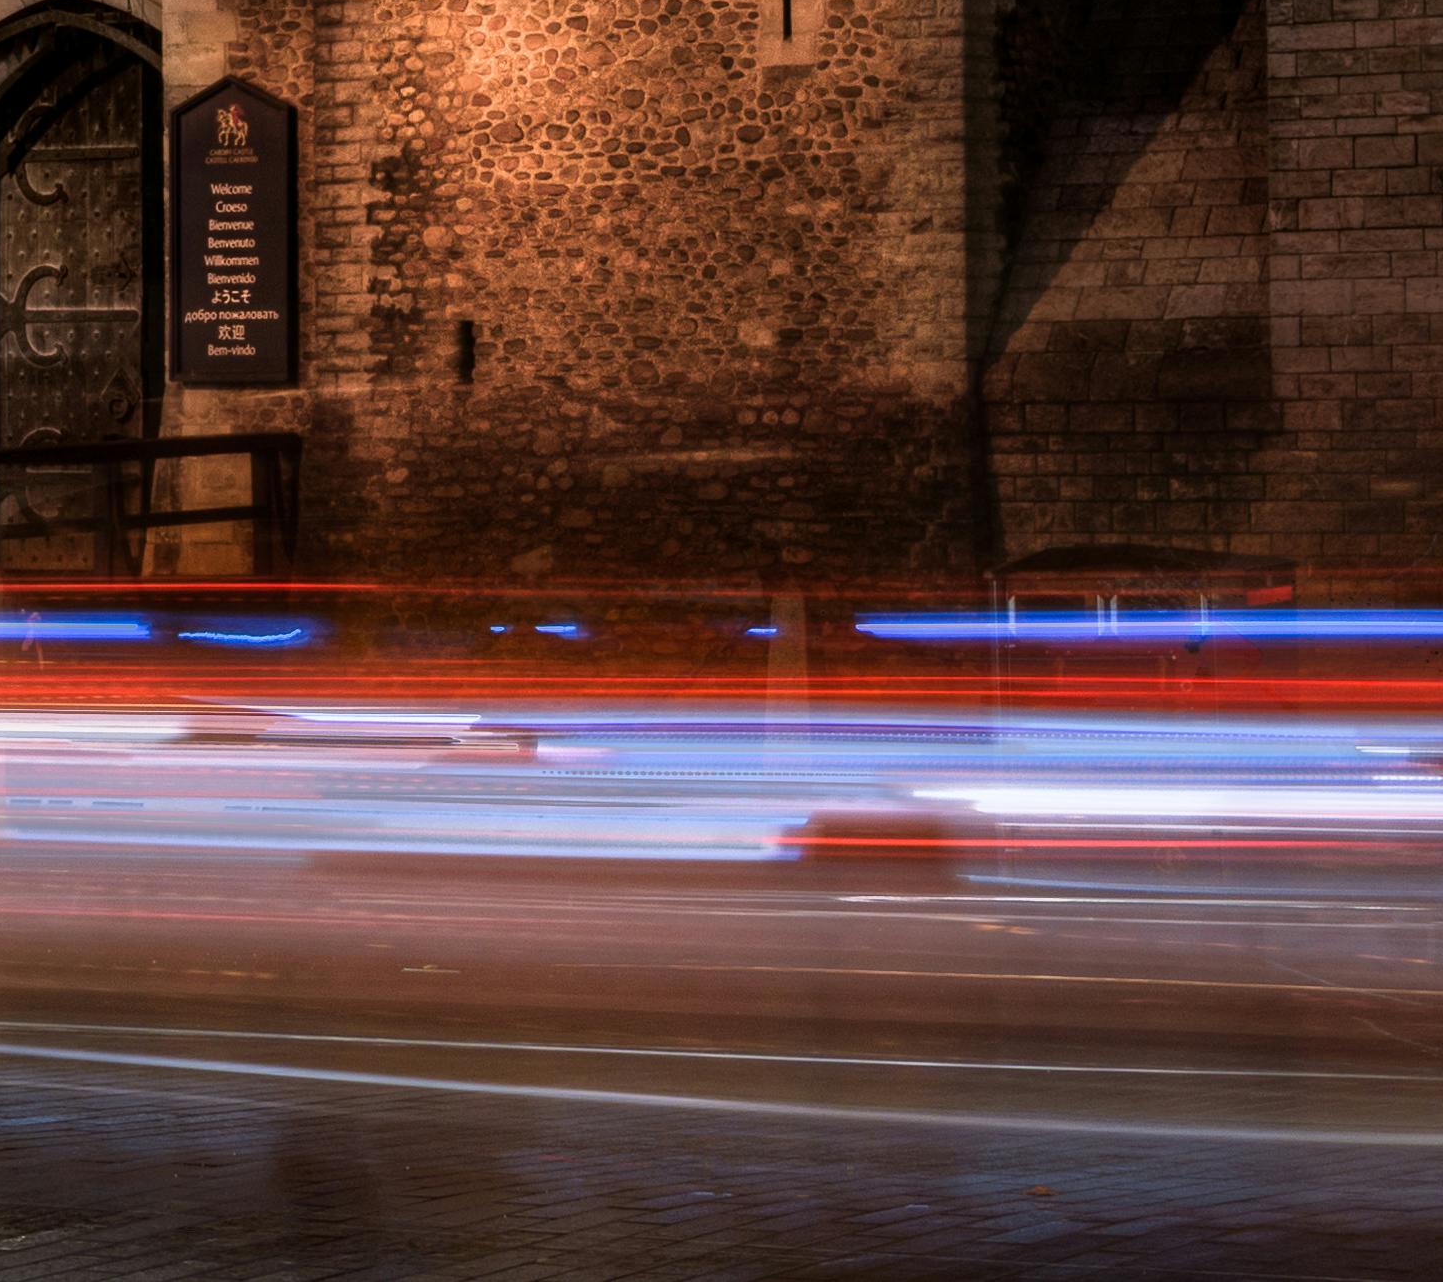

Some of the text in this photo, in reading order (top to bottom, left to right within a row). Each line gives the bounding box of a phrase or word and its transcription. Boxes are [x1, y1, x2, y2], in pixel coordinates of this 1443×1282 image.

[211, 183, 253, 195] Welcome
[215, 200, 248, 213] Croeso
[208, 219, 255, 231] Bienvenue
[207, 237, 256, 249] Benvenuto
[204, 255, 260, 267] Willkommen
[207, 273, 256, 285] Bienvenido
[211, 289, 252, 304] ようこそ
[184, 308, 279, 323] добро пожаловать
[218, 324, 246, 340] 欢迎
[207, 343, 256, 356] Bem-vindo
